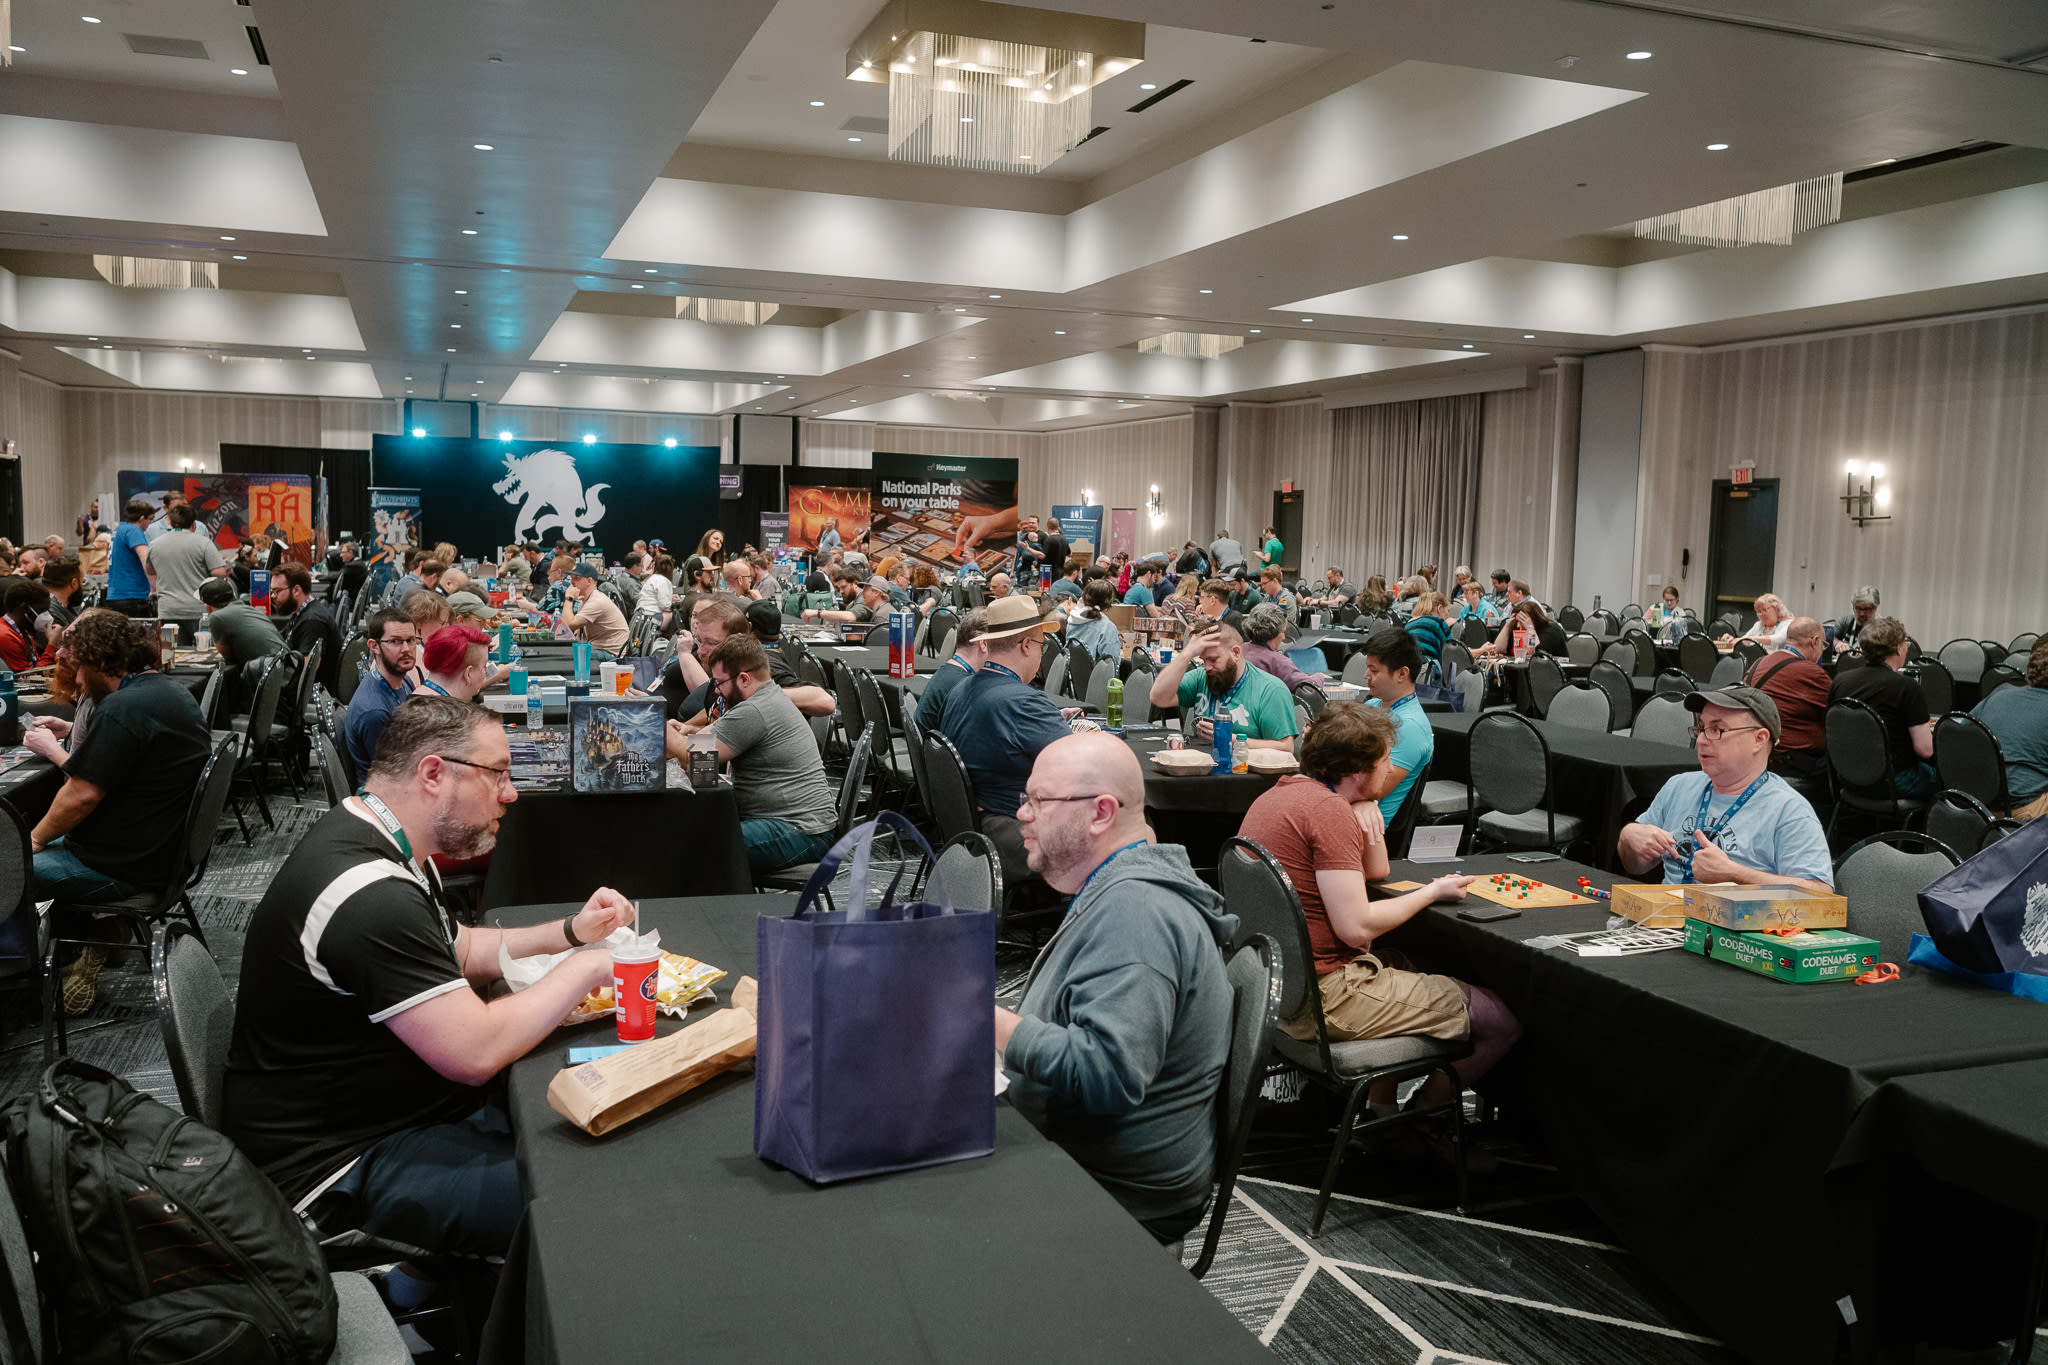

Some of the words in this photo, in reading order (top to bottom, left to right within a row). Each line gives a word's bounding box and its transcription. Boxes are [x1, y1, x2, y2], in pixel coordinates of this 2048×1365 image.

[936, 463, 967, 472] Keymaster
[881, 480, 931, 495] National
[931, 482, 962, 496] Parks
[255, 492, 300, 523] RA
[881, 497, 898, 508] on
[900, 498, 928, 510] your
[928, 497, 960, 509] table
[628, 752, 640, 762] My
[616, 759, 650, 773] Father's
[621, 772, 646, 785] Work
[1719, 936, 1774, 962] CODENAMES
[1735, 952, 1754, 965] DUET
[1762, 960, 1774, 972] XXL
[1802, 953, 1857, 968] CODENAMES
[1819, 965, 1839, 976] DUET
[1844, 964, 1858, 976] XXL
[1275, 1086, 1298, 1100] CON
